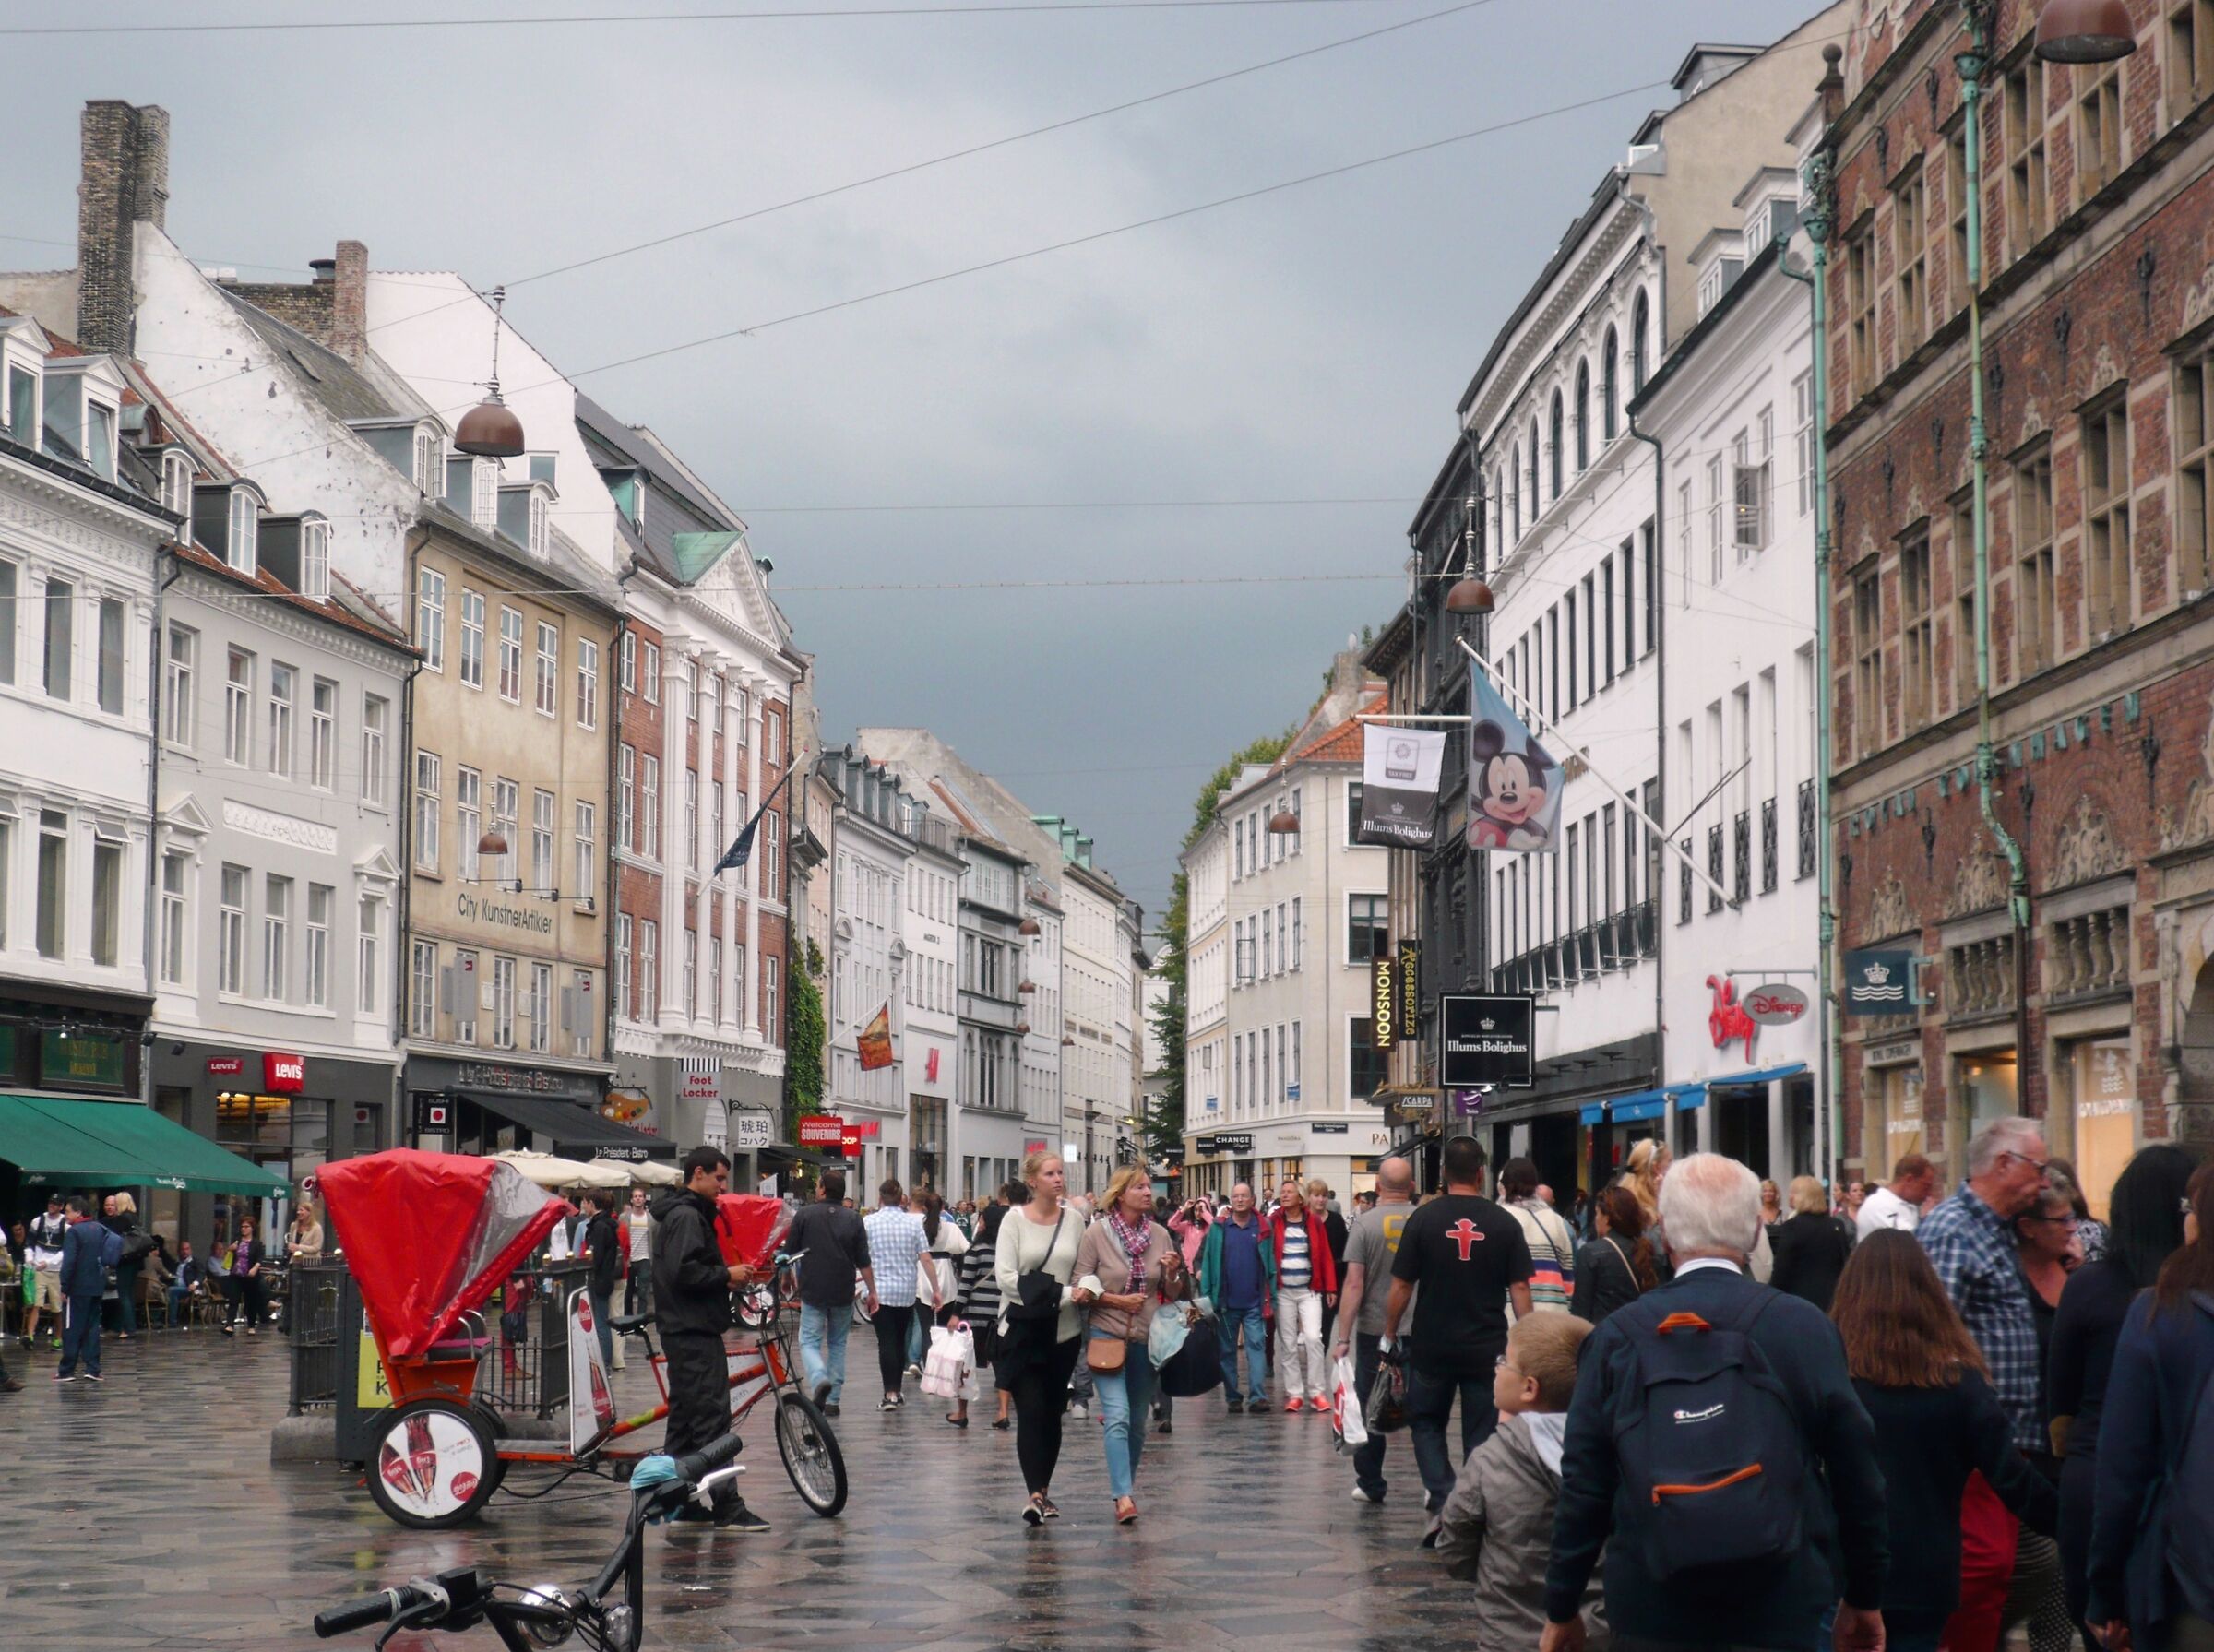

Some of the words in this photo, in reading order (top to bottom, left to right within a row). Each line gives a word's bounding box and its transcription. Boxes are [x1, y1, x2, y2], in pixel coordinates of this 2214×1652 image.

[1363, 819, 1393, 833] Illums
[1393, 824, 1433, 838] Bolighus
[458, 893, 478, 922] City
[482, 898, 553, 934] KunstnerArtikler
[1376, 961, 1391, 1047] MONSOON
[1447, 1040, 1482, 1052] Illums
[1482, 1040, 1528, 1054] Bolighus
[689, 1075, 712, 1086] Foot
[683, 1087, 719, 1098] Locker
[1401, 1096, 1432, 1106] SCARPA
[741, 1120, 768, 1133] 琥珀
[801, 1128, 841, 1141] SOUVENIRS
[740, 1137, 768, 1146] コハク
[632, 1147, 648, 1159] Bistro
